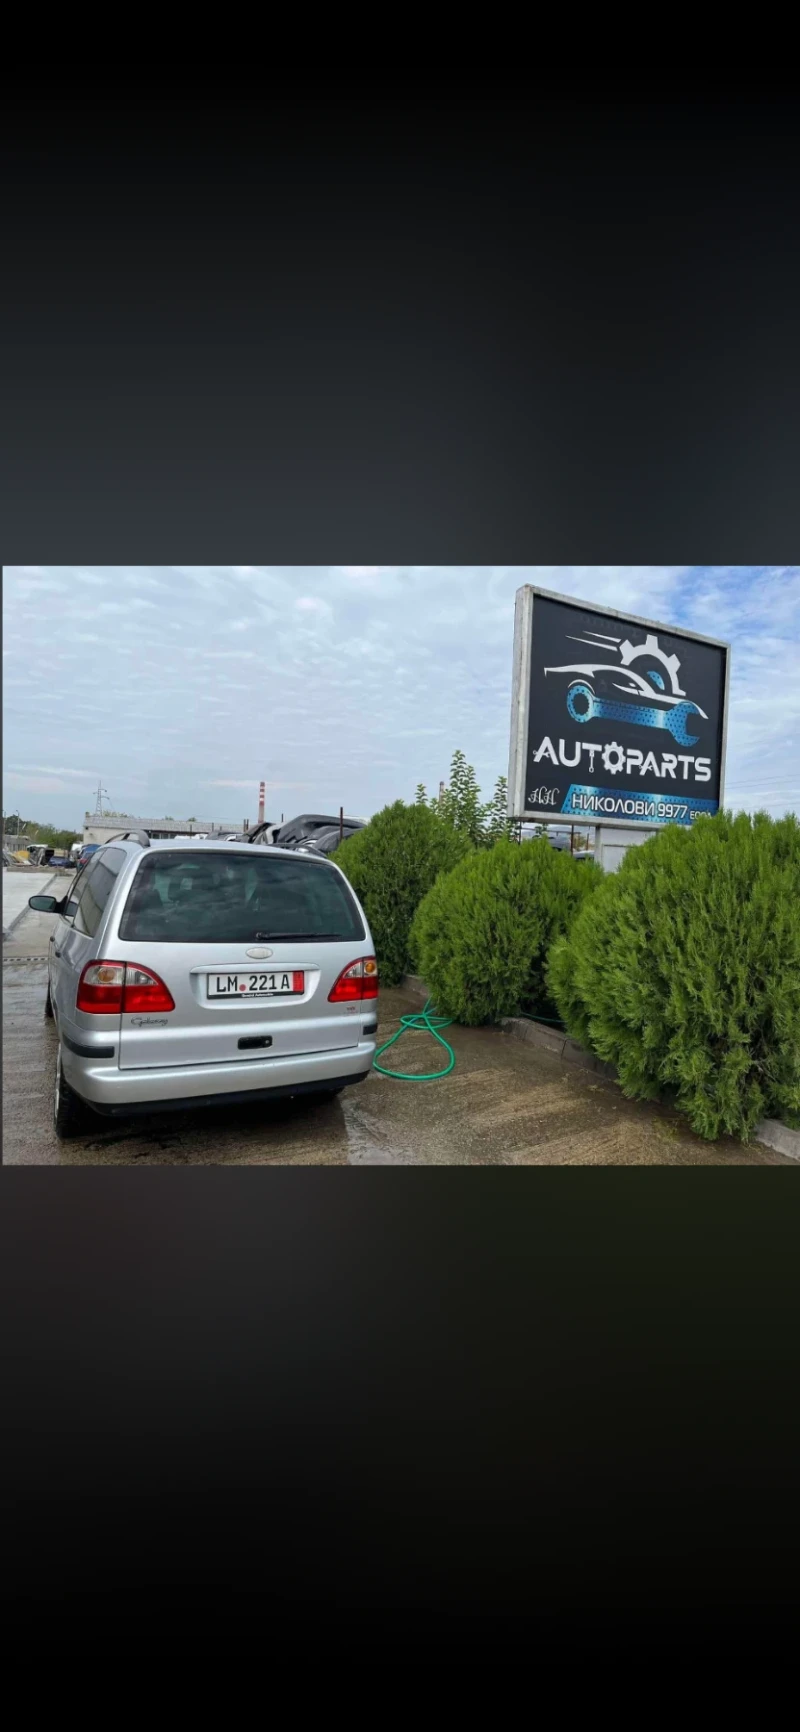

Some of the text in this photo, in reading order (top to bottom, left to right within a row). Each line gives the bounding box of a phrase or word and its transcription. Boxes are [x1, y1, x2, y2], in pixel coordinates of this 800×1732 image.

[533, 736, 711, 781] AUTOPARTS
[572, 793, 655, 816] НИКОЛОВИ
[658, 803, 687, 818] 9977
[216, 976, 238, 992] LM
[249, 975, 276, 991] 221
[281, 974, 290, 989] A
